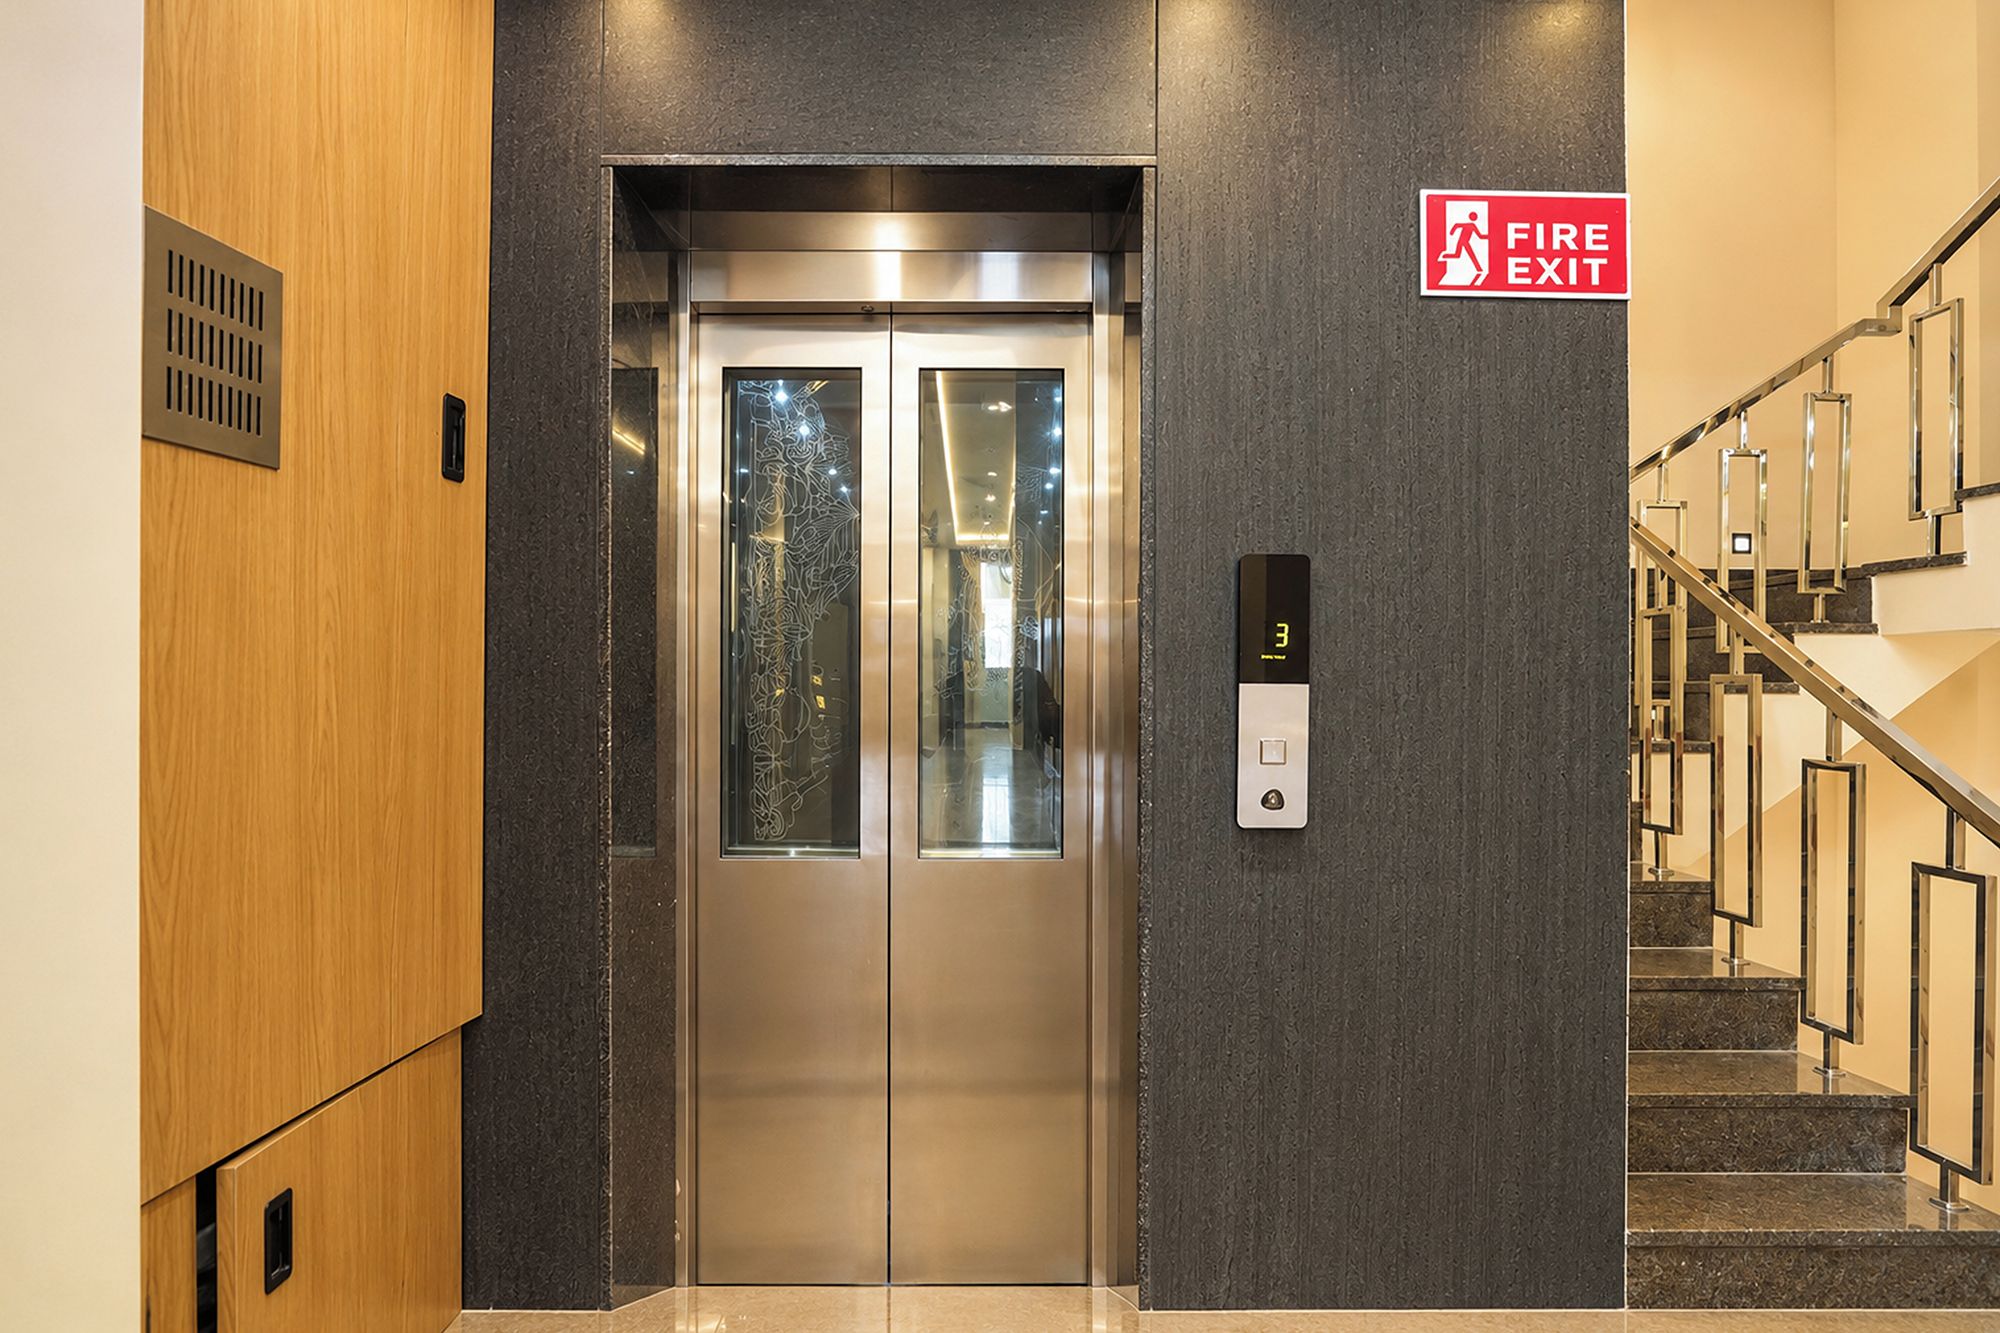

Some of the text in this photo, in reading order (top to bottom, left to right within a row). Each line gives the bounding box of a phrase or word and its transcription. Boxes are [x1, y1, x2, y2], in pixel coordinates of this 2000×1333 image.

[1507, 222, 1609, 251] FIRE
[1507, 257, 1608, 286] EXIT
[1275, 623, 1289, 647] 3
